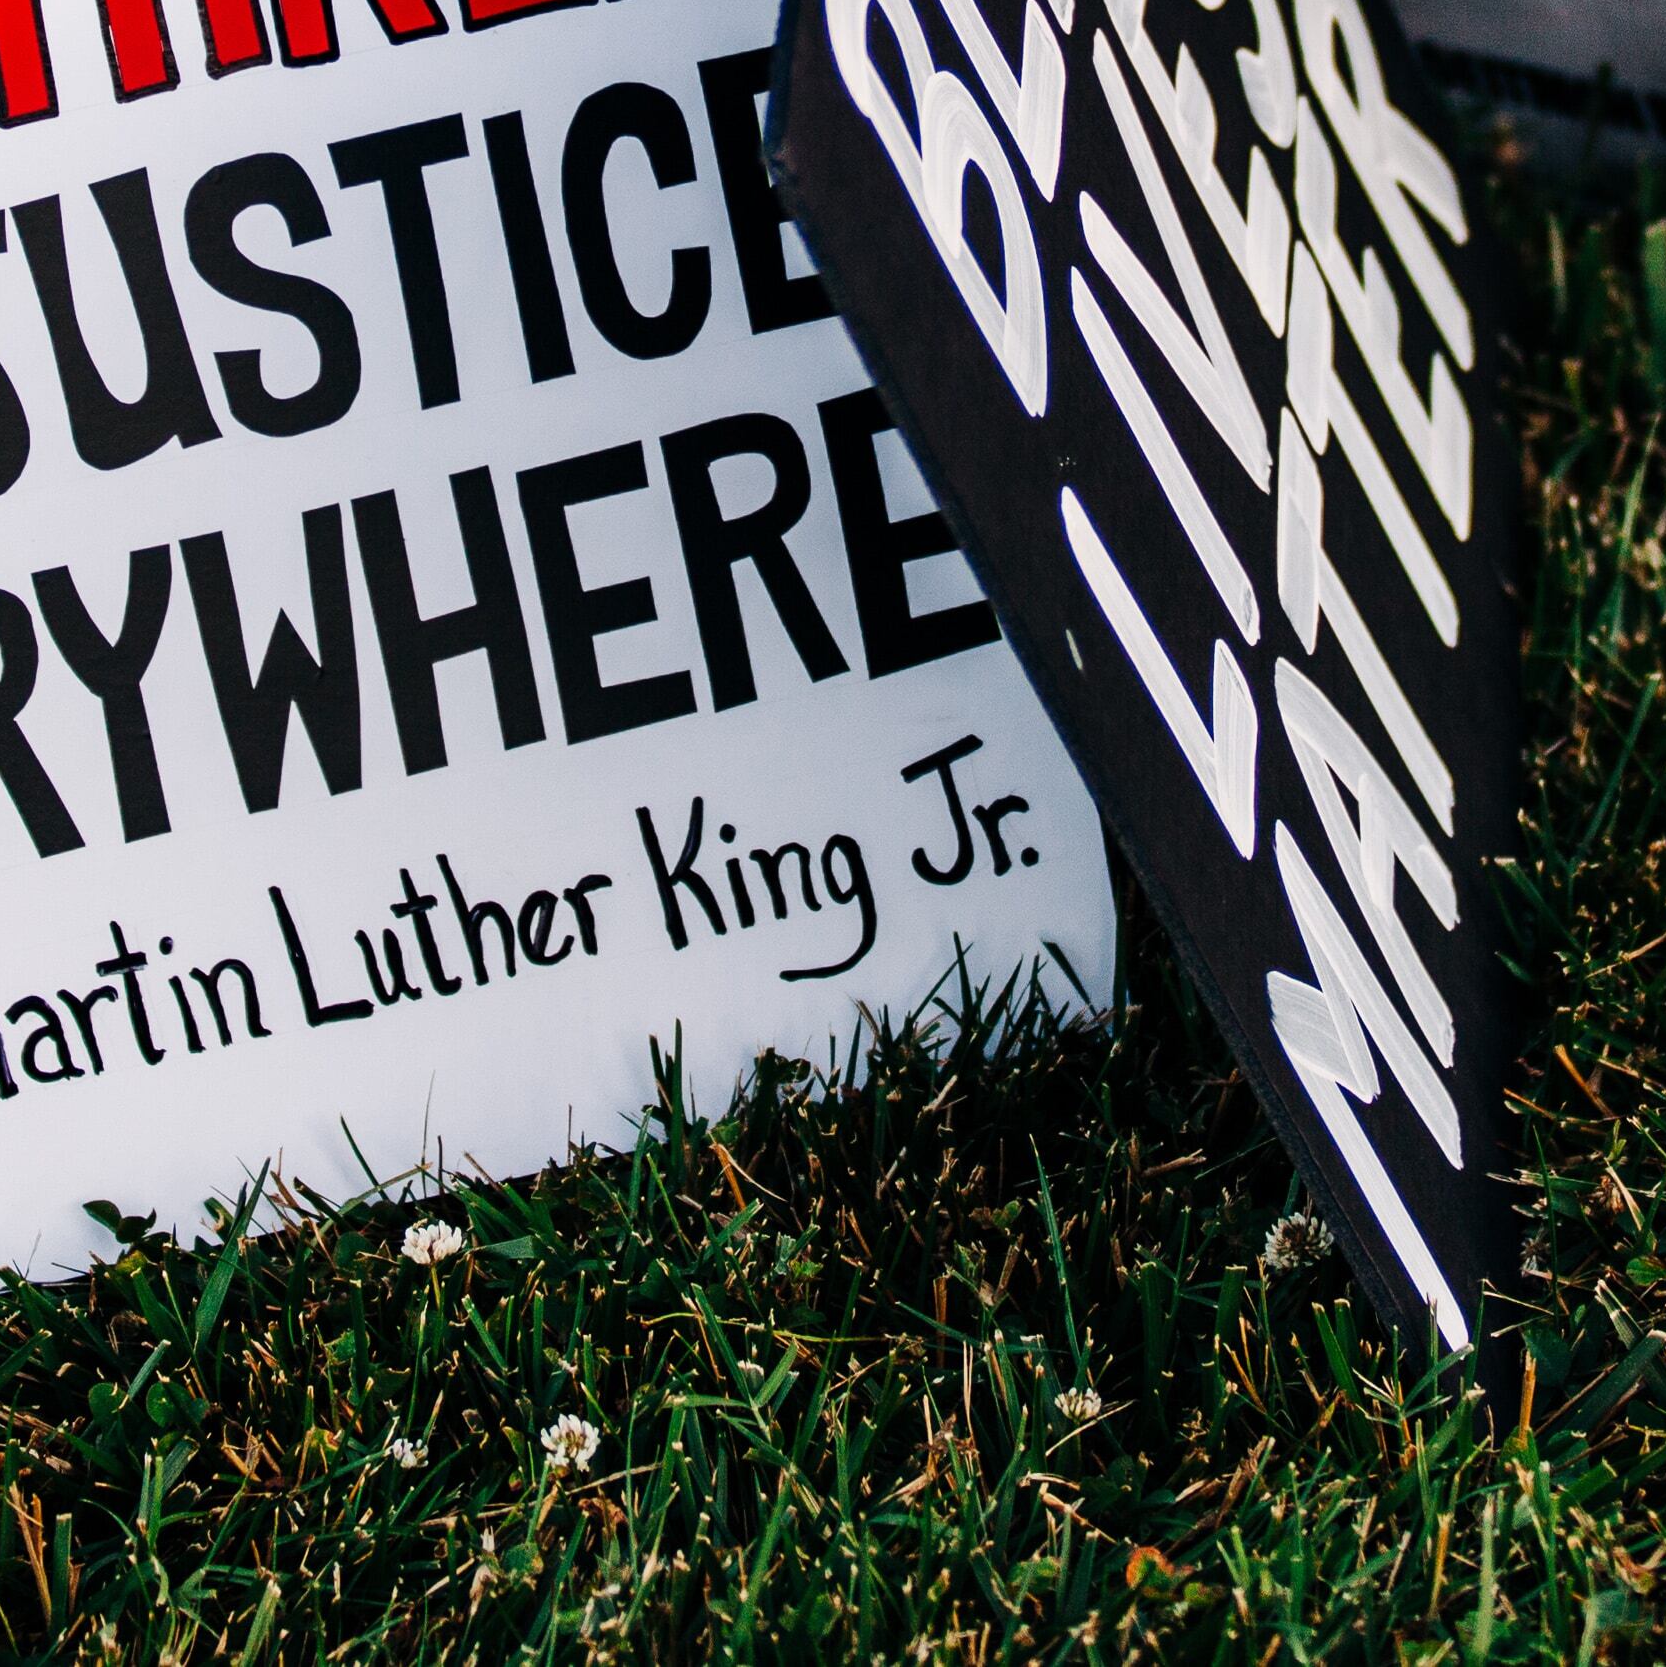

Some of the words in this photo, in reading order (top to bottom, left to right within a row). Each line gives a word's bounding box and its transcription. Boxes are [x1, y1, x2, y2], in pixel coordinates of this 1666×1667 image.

[269, 853, 613, 1028] Luther
[634, 796, 879, 984] King
[901, 734, 1040, 869] Jr.
